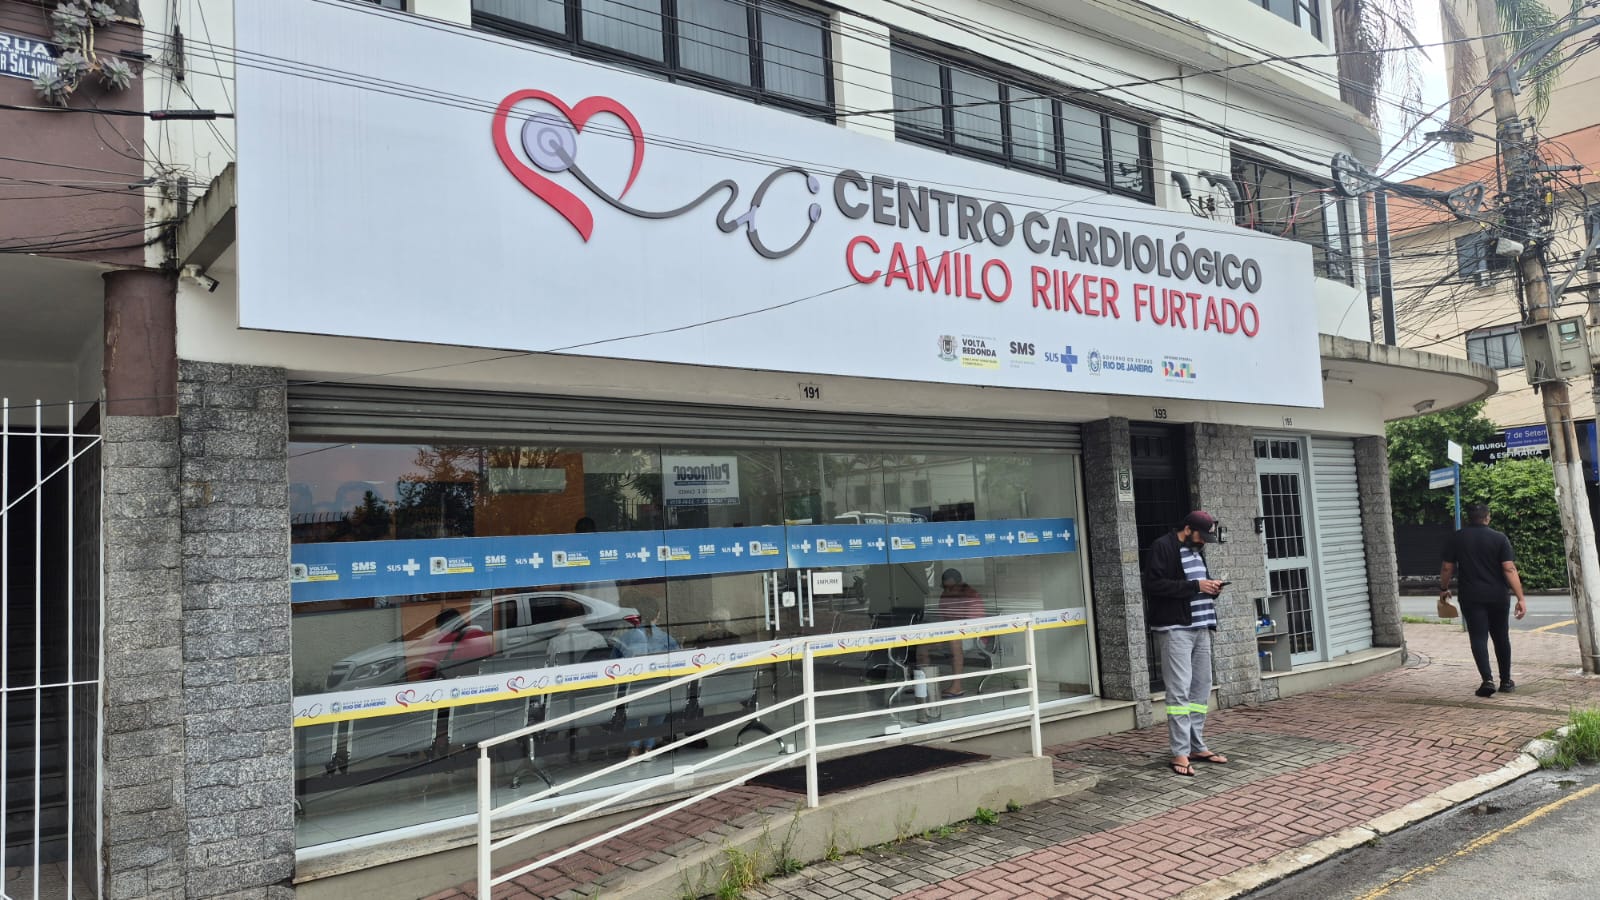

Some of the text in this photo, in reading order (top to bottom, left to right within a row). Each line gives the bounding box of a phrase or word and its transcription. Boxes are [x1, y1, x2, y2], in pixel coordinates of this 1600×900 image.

[0, 35, 50, 57] RUA
[834, 169, 1262, 293] CENTRO CARDIOLÓGICO
[846, 235, 1260, 337] CAMILO RIKER FURTADO
[962, 338, 986, 348] VOLTA
[962, 347, 997, 357] REDONDA
[1009, 341, 1035, 356] SMS
[1044, 352, 1059, 362] SUS
[1103, 361, 1153, 373] RIO DE JANEIRO
[804, 386, 820, 399] 191
[1154, 408, 1167, 419] 193
[1506, 432, 1511, 440] 7
[600, 549, 618, 558] SMS
[485, 555, 507, 564] SMS
[352, 561, 376, 571] SMS
